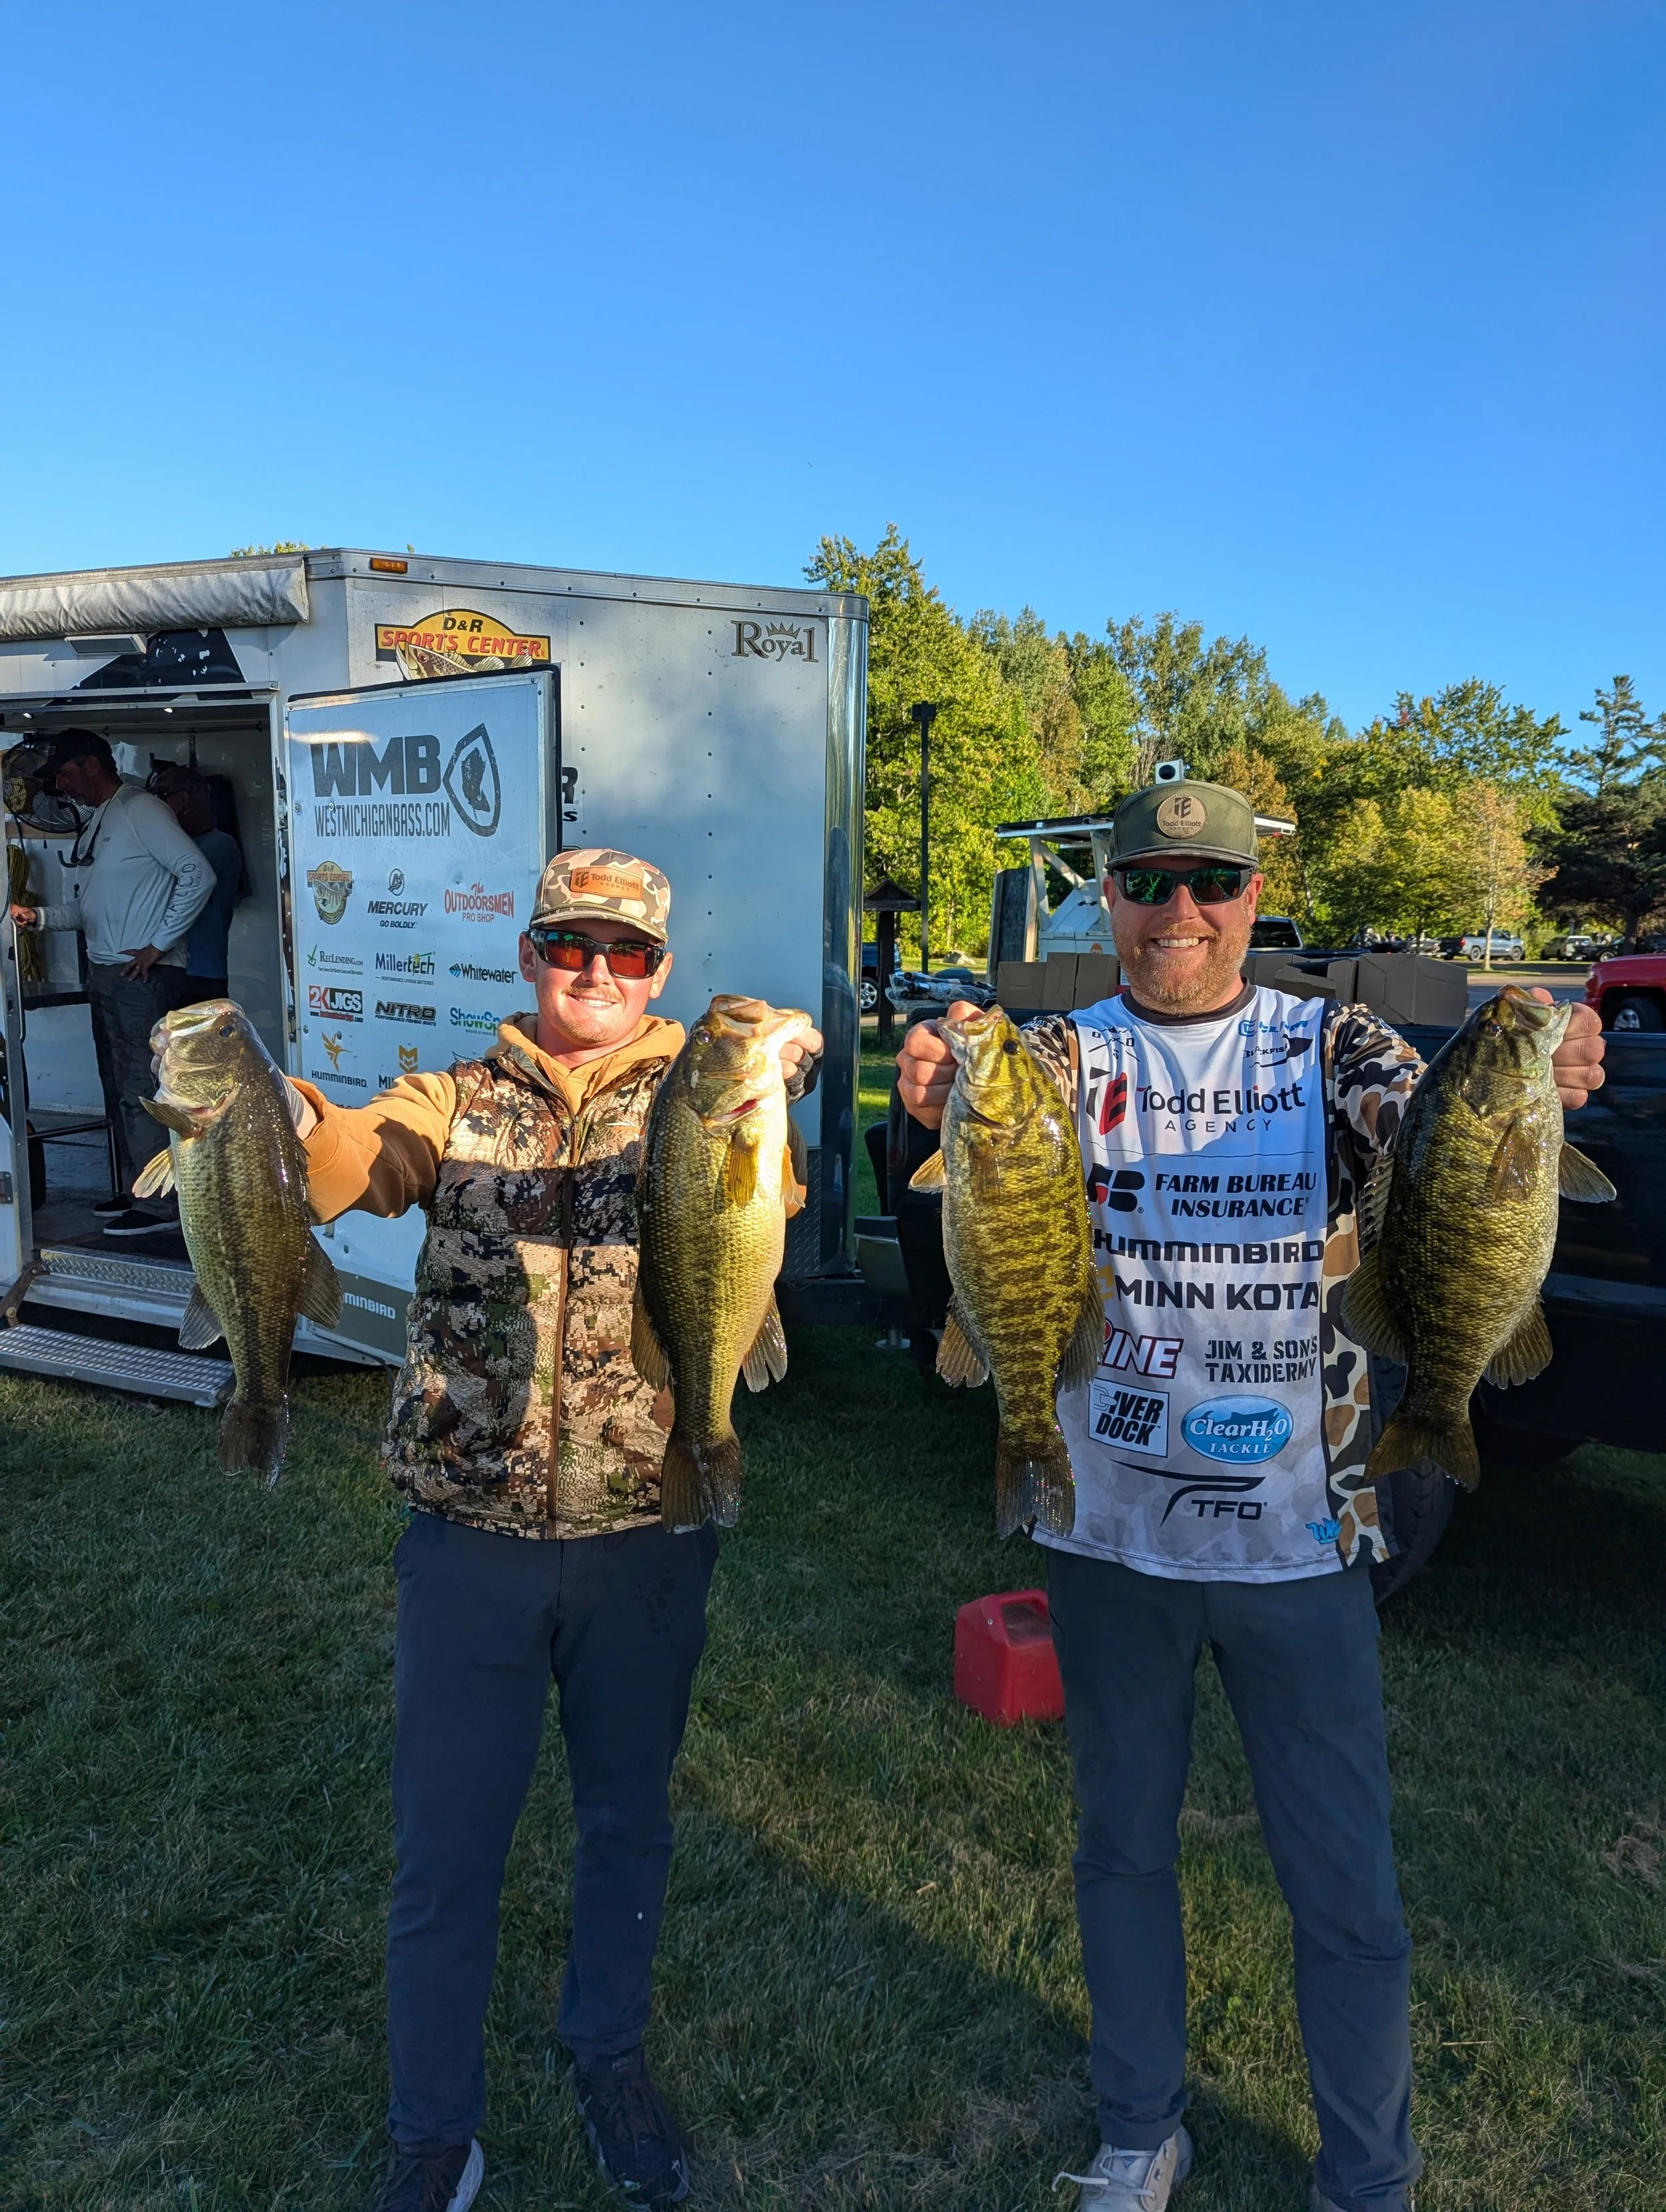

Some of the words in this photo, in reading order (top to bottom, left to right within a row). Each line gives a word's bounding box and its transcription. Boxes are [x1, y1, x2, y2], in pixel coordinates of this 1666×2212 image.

[442, 617, 483, 633] D&R
[381, 630, 458, 650] SPORTS
[467, 636, 541, 657] CENTER
[730, 620, 819, 663] Royal
[311, 734, 440, 797] WMB
[315, 802, 450, 837] WESTMICHIGANBASS.COM
[471, 881, 484, 896] The
[615, 876, 639, 890] Elliott
[368, 901, 428, 916] MERCURY
[444, 889, 514, 918] OUTDOORSMEN
[462, 913, 475, 921] PRO
[477, 913, 494, 923] SHOP
[375, 953, 434, 975] Millertech
[461, 963, 516, 983] Whitewater
[375, 1000, 436, 1021] NITRO
[450, 1007, 500, 1036] ShowSp
[311, 1070, 367, 1087] HUMMINBIRD
[1136, 1085, 1205, 1115] Todd
[1214, 1082, 1306, 1115] Elliott
[1165, 1119, 1271, 1132] AGENCY
[1156, 1173, 1220, 1193] FARM
[1226, 1172, 1317, 1193] BUREAU
[1171, 1197, 1304, 1218] INSURANCE
[1094, 1229, 1325, 1264] HUMMINBIRD
[1115, 1275, 1214, 1310] MINN
[1226, 1281, 1319, 1311] KOTA
[1205, 1340, 1243, 1360] JIM
[1251, 1341, 1267, 1360] &
[1273, 1334, 1317, 1359] SON'S
[1205, 1357, 1317, 1383] TAXIDERMY
[1096, 1412, 1156, 1446] DOCK
[1210, 1443, 1271, 1454] TACKLE
[1191, 1499, 1263, 1520] TFO
